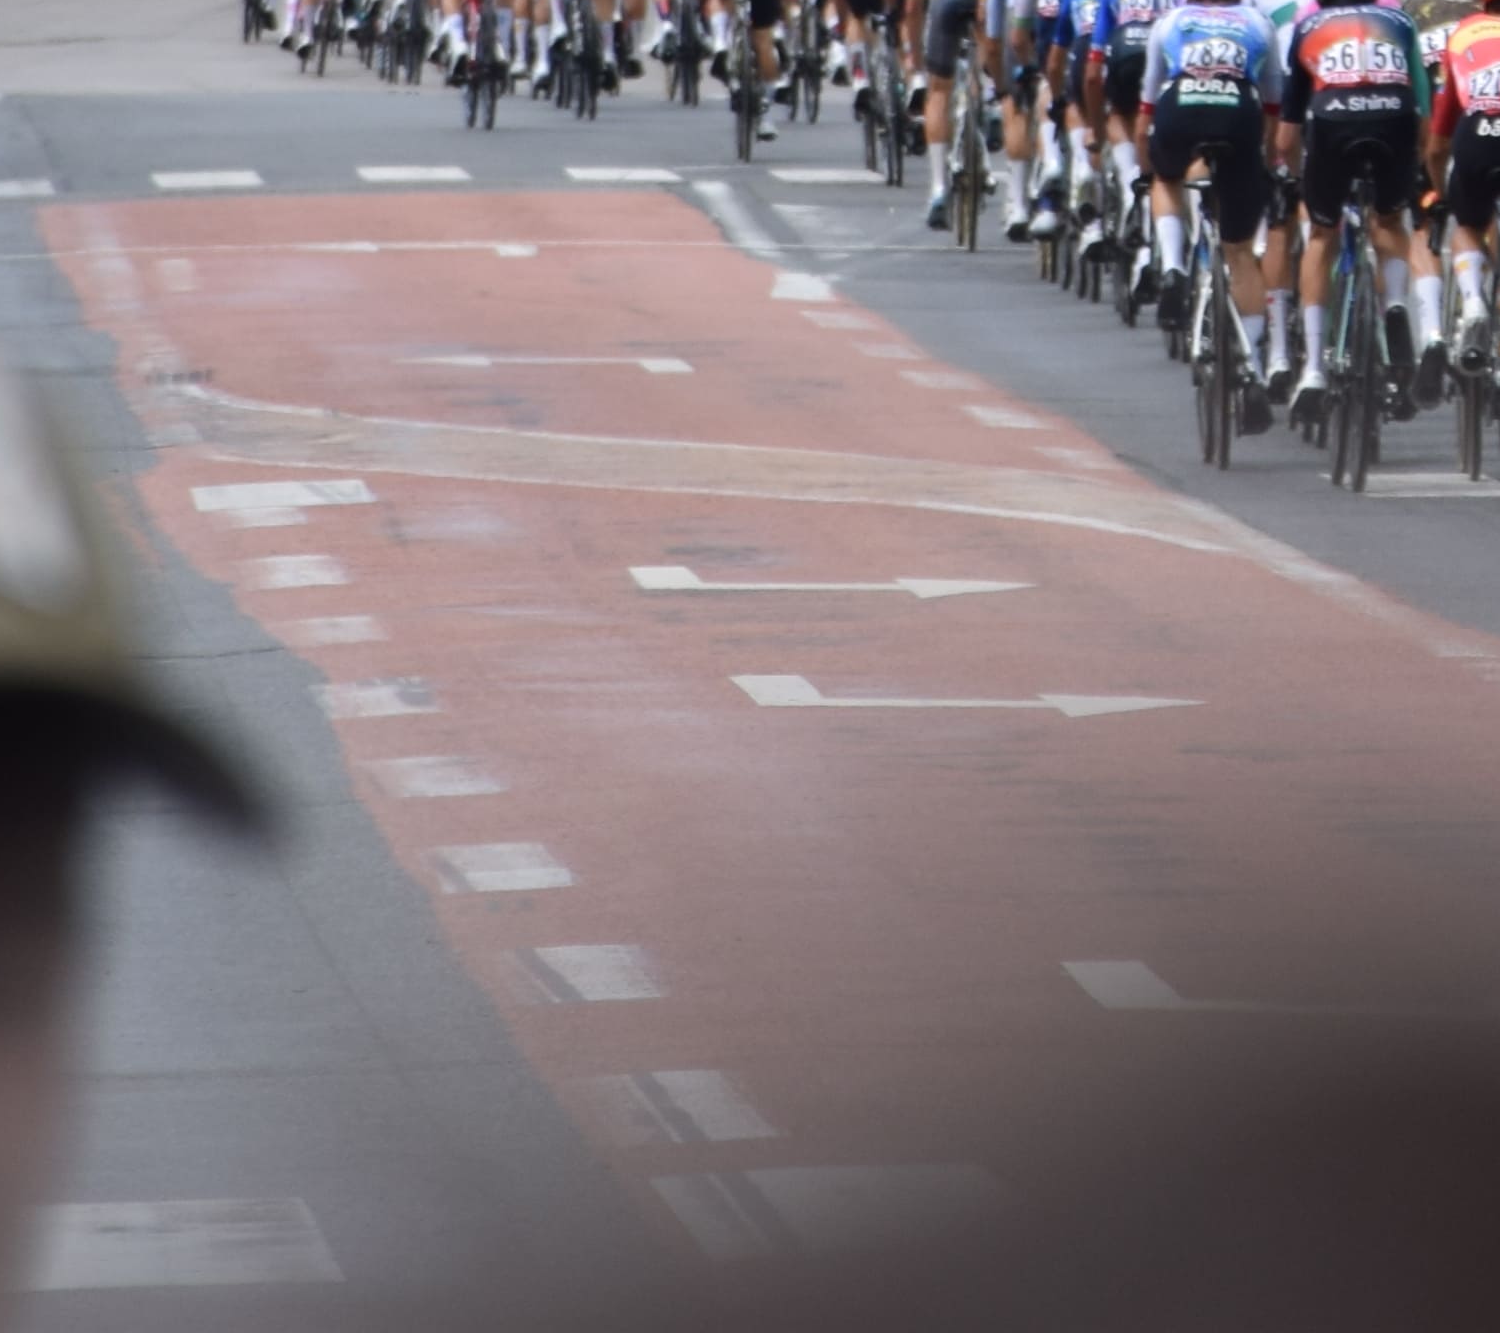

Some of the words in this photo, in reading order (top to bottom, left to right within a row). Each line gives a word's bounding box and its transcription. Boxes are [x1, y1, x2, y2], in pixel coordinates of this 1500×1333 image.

[1324, 43, 1356, 72] 56
[1372, 42, 1406, 71] 56
[1180, 78, 1241, 95] BORA
[1349, 94, 1401, 111] Shine
